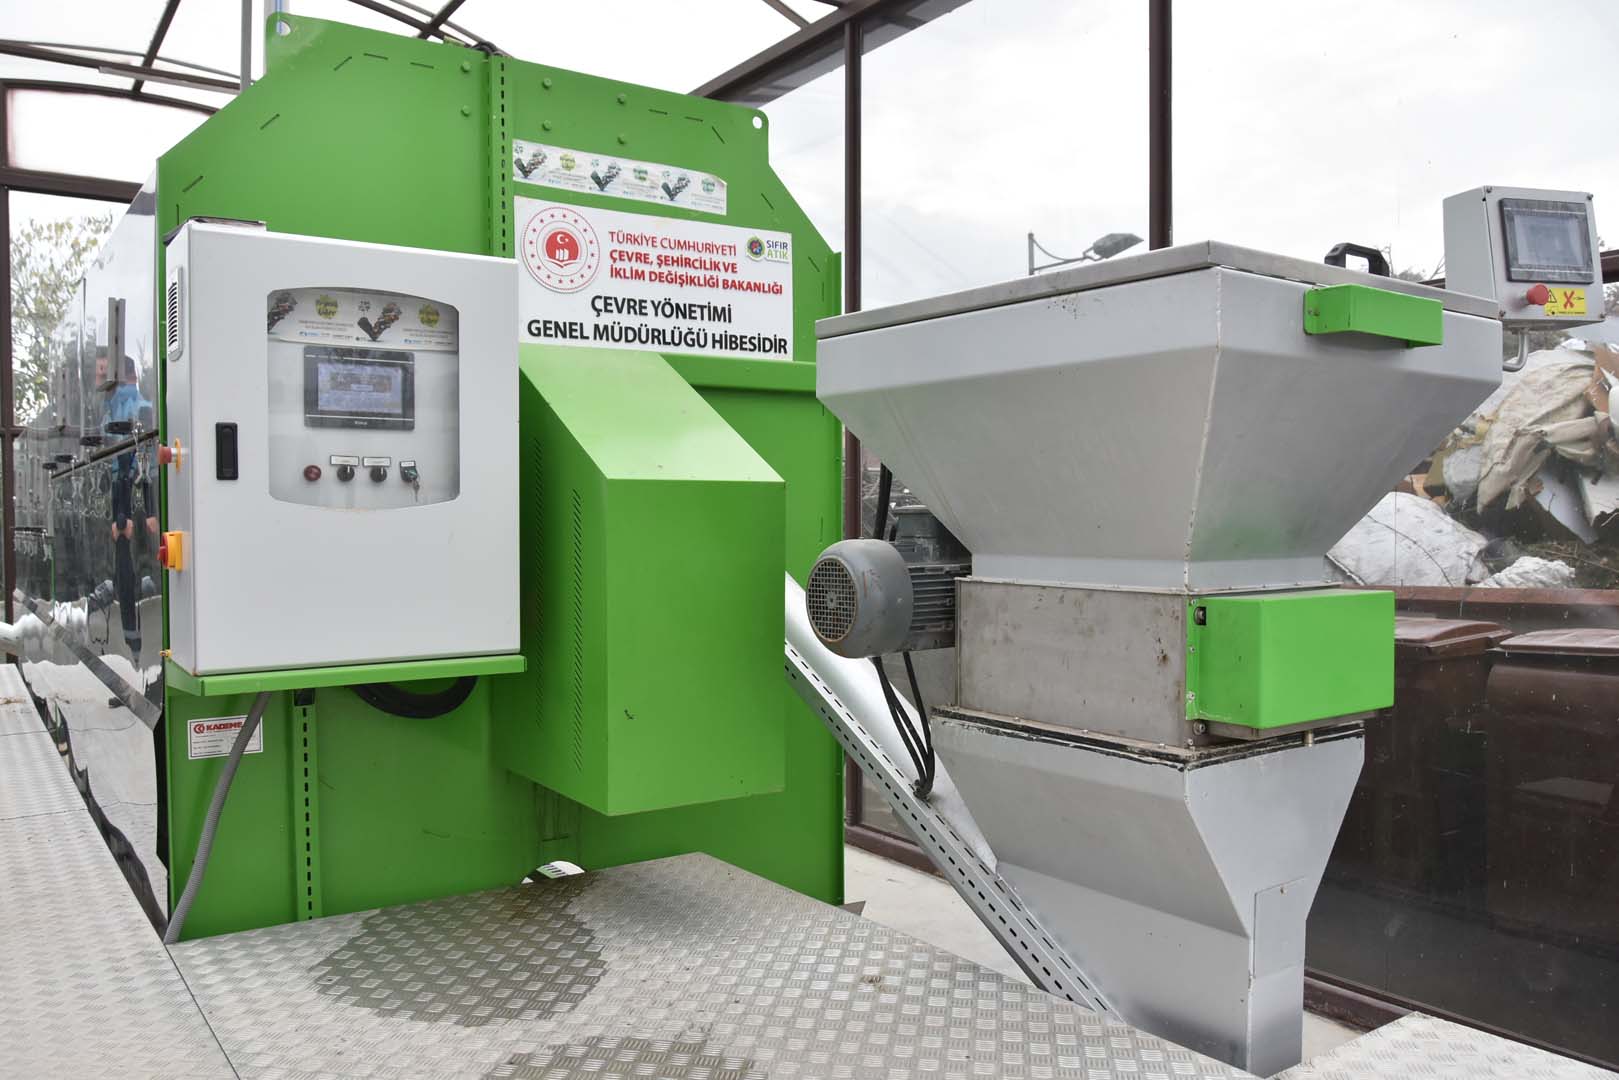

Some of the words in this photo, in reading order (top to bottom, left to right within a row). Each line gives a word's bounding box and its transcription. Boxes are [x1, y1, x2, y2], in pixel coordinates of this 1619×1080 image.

[608, 230, 658, 248] TÜRKİYE
[660, 236, 737, 257] CUMHURİYETİ
[766, 239, 789, 251] SIFIR
[767, 248, 789, 260] ATIK
[609, 249, 654, 266] ÇEVRE,
[656, 253, 721, 272] ŞEHİRCİLİK
[722, 260, 738, 274] VE
[610, 264, 646, 281] İKLİM
[648, 270, 719, 288] DEĞİŞİKLİĞİ
[722, 277, 783, 295] BAKANLIĞI
[590, 295, 648, 318] ÇEVRE
[650, 297, 732, 323] YÖNETİMİ
[527, 319, 590, 340] GENEL
[593, 321, 708, 348] MÜDÜRLÜĞÜ
[711, 330, 788, 355] HİBESİDİR
